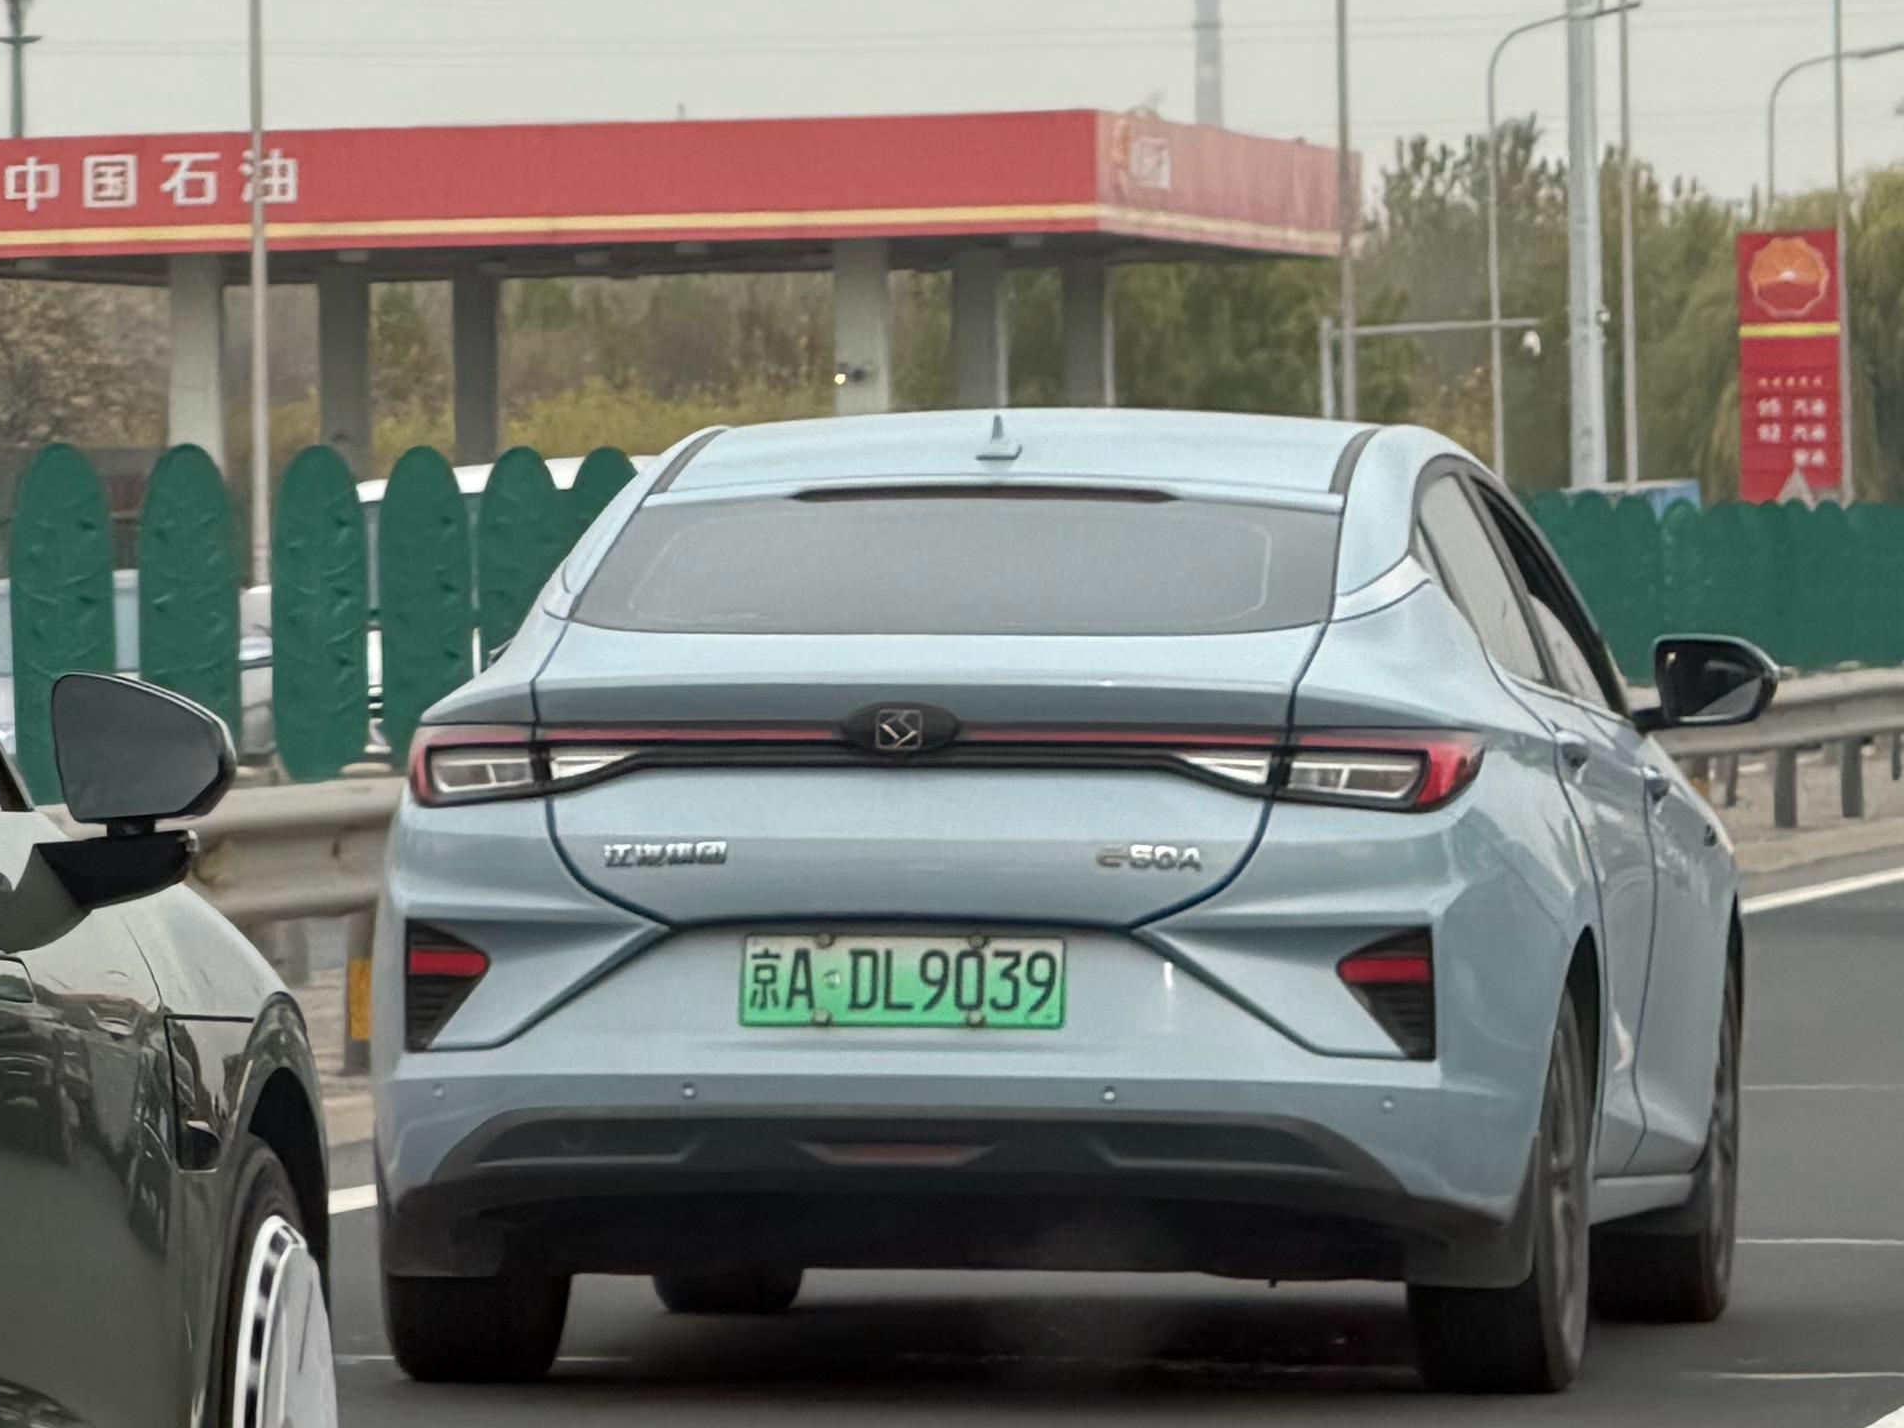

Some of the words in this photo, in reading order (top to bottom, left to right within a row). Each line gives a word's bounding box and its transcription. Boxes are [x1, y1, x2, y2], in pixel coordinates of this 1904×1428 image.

[4, 148, 299, 212] 中国石油
[749, 948, 815, 1011] 京A
[847, 948, 1058, 1020] DL9039
